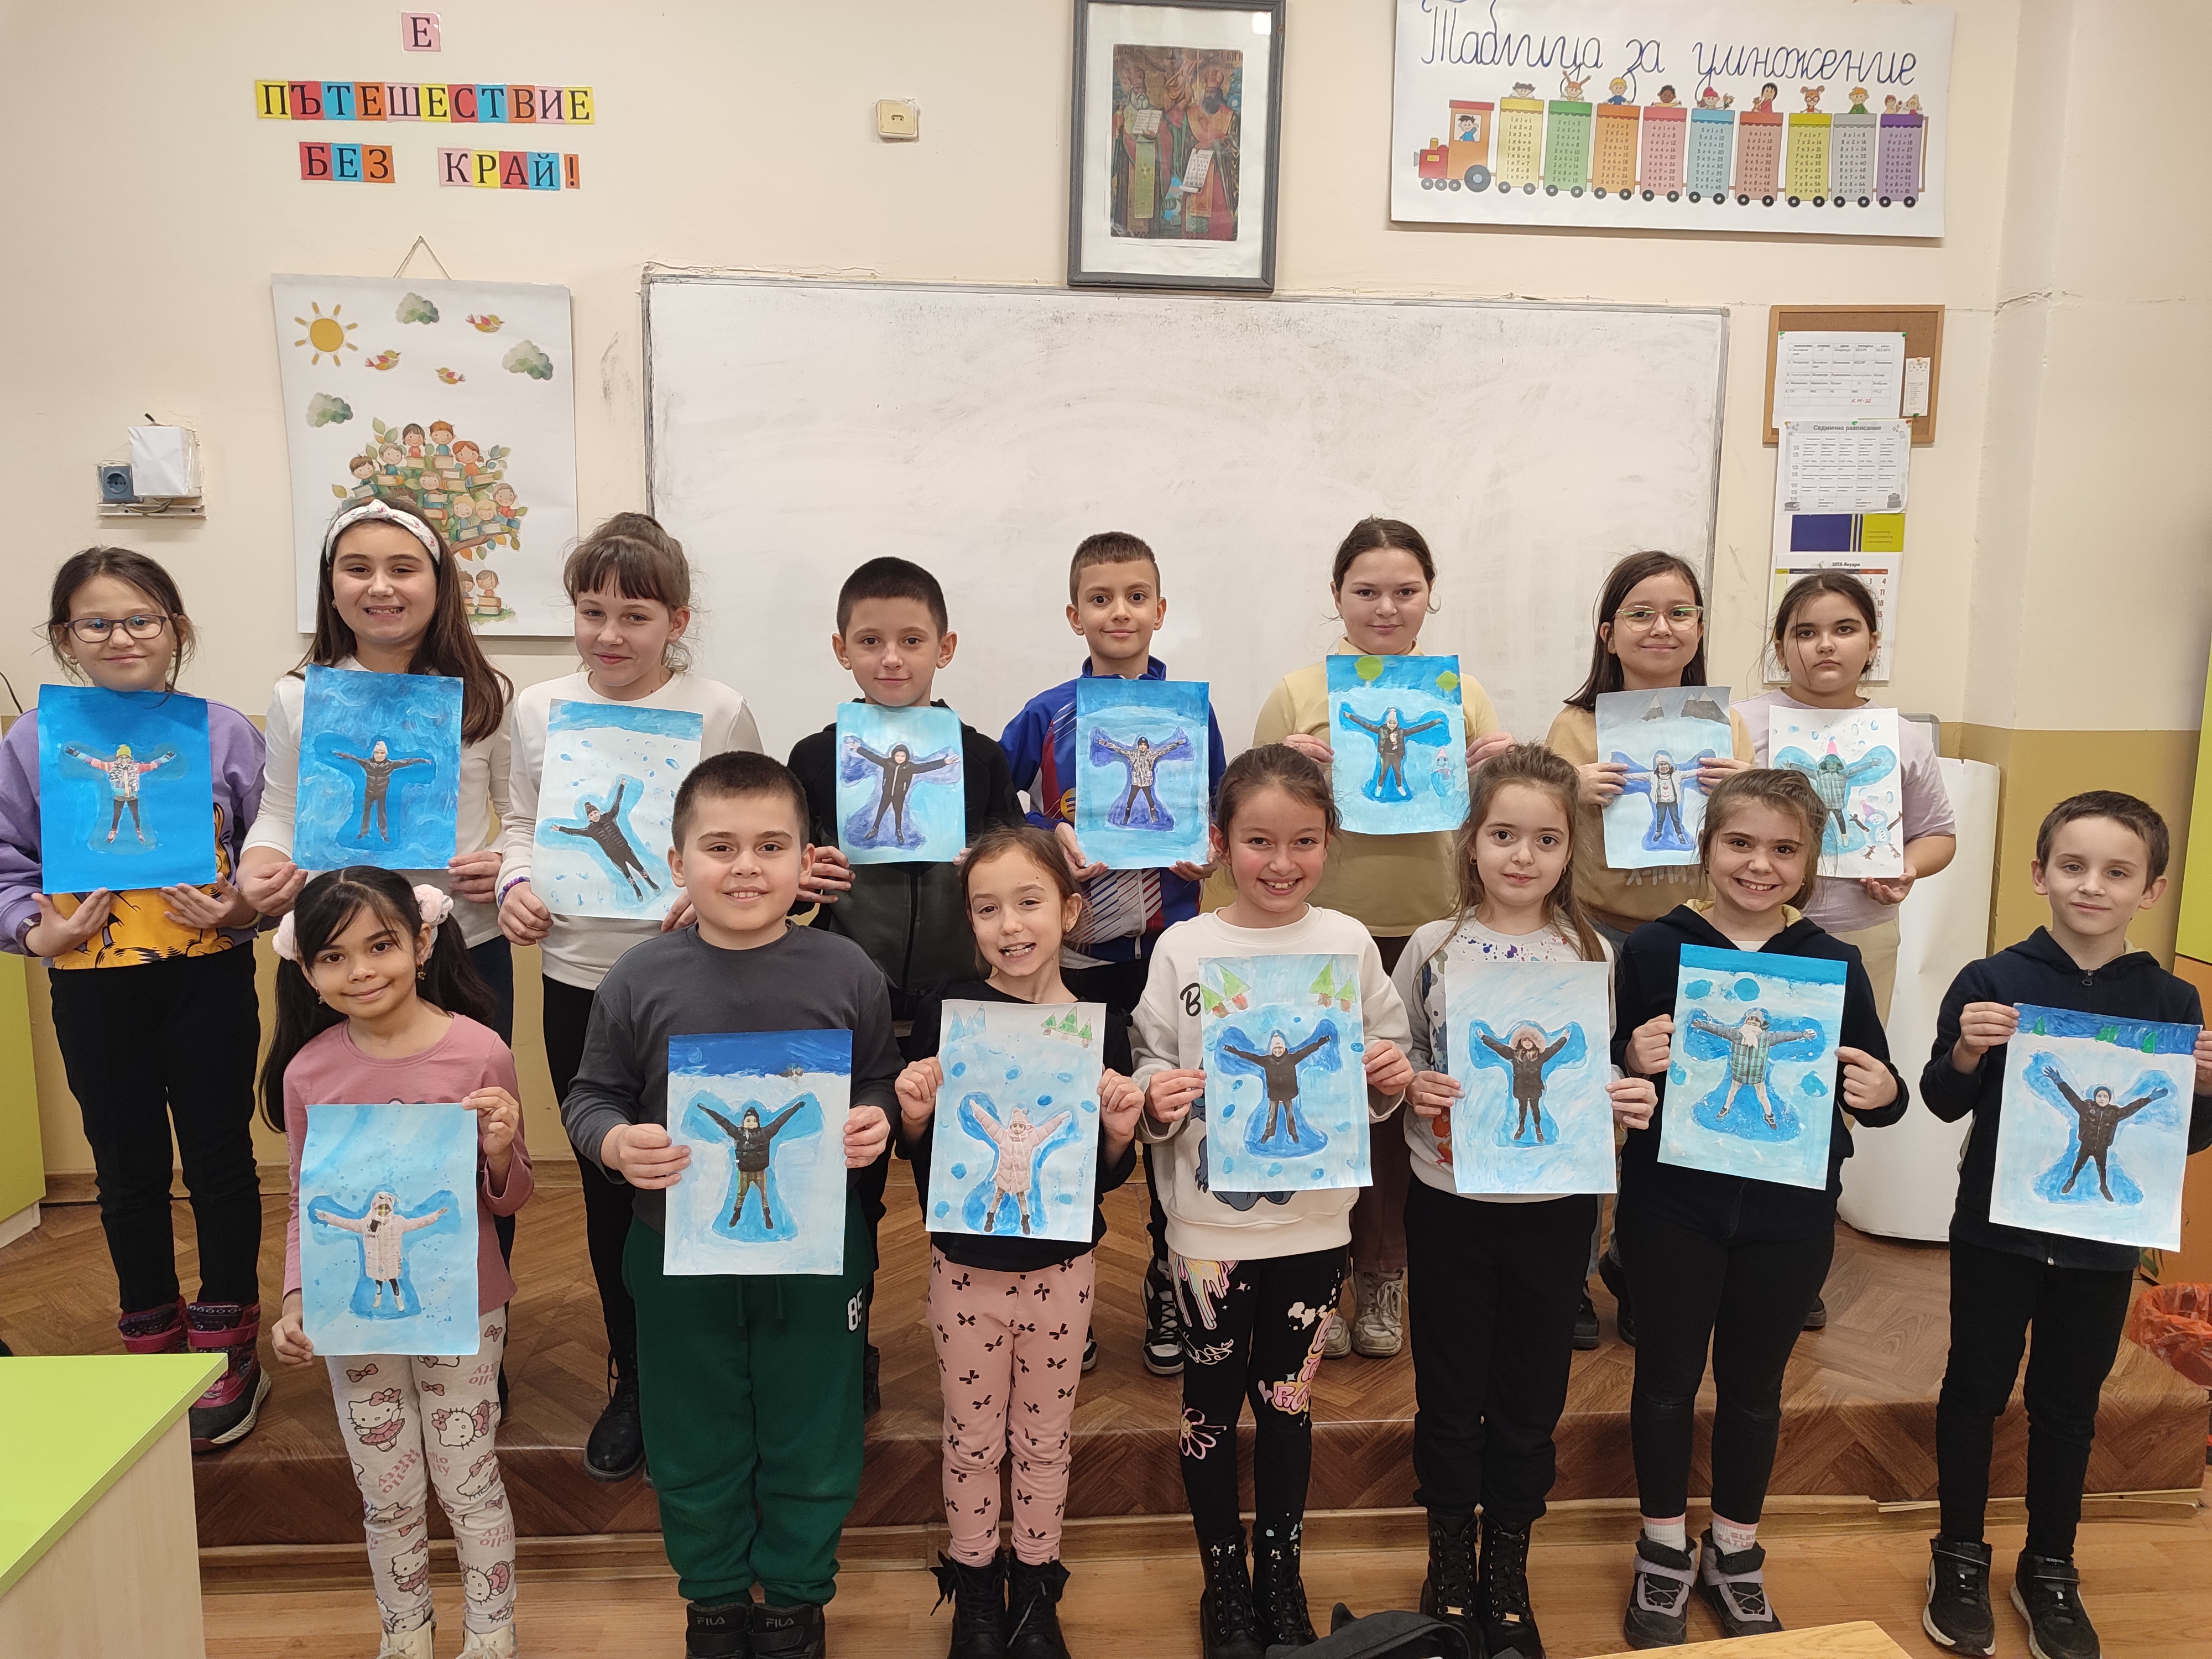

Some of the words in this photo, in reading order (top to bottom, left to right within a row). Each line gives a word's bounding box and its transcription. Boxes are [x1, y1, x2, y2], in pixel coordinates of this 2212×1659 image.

[410, 16, 433, 48] Е
[1622, 39, 1666, 103] за
[1692, 41, 1917, 102] умножение
[263, 84, 591, 121] ПЪТЕШЕСТВИЕ
[305, 145, 389, 179] БЕЗ
[847, 1288, 863, 1331] 85
[697, 1616, 726, 1626] FILA
[766, 1617, 795, 1628] FILA
